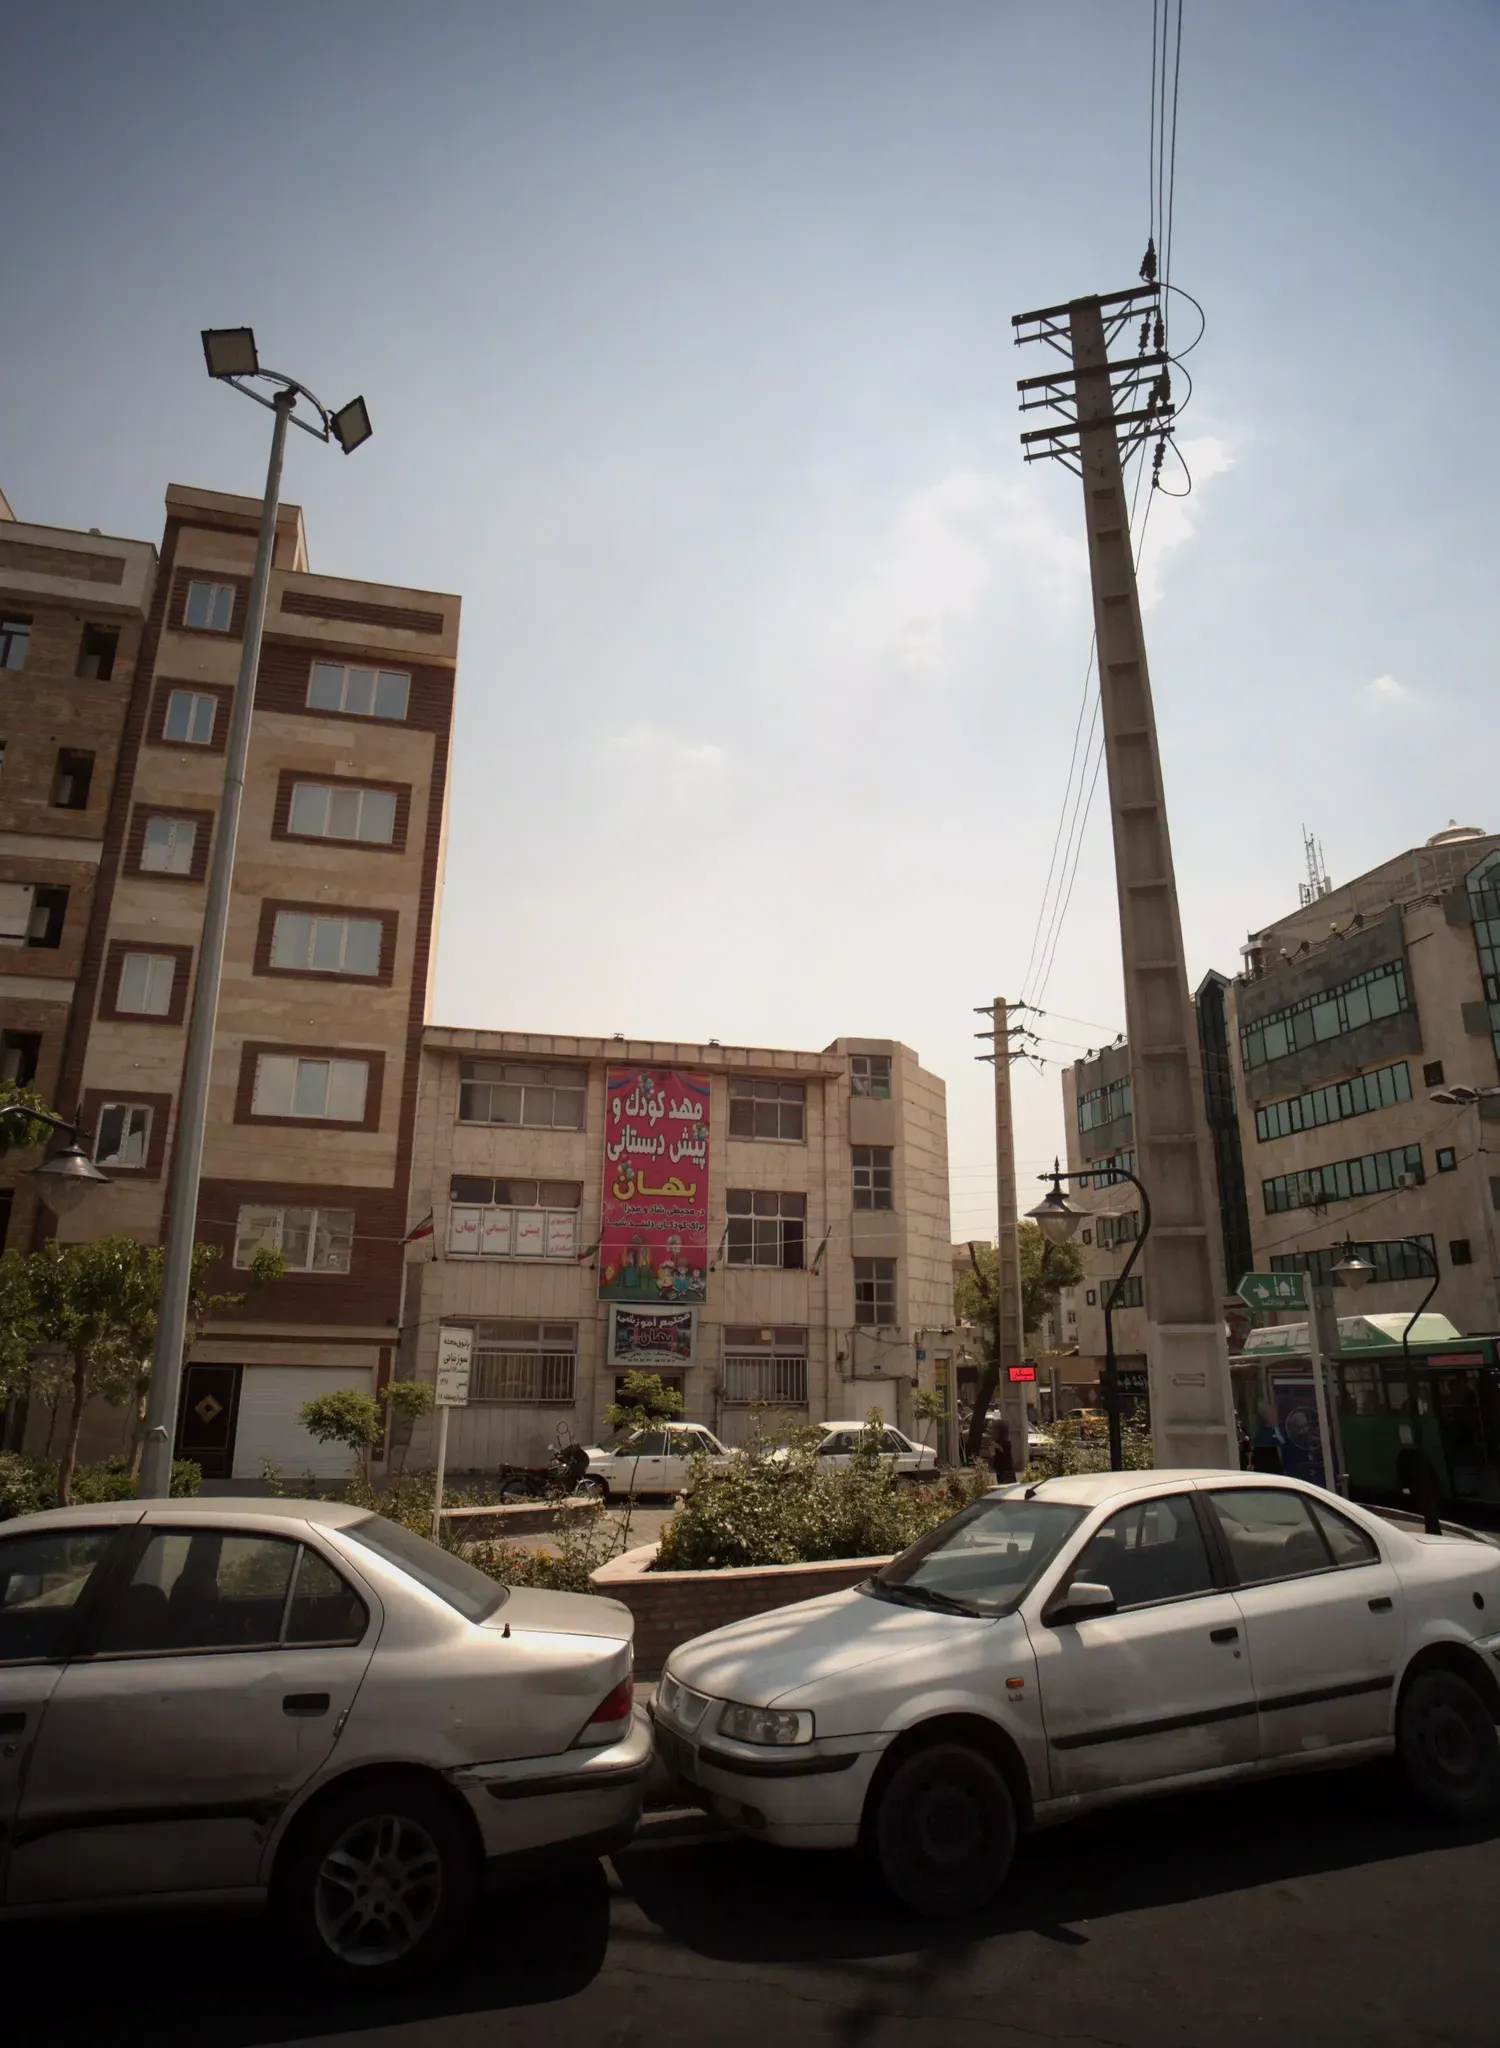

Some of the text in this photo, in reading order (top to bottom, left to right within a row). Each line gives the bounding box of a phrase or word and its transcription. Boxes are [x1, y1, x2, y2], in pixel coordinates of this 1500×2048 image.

[612, 1096, 622, 1125] و
[668, 1096, 703, 1121] مهد
[606, 1123, 706, 1171] پیش دبستانی
[612, 1169, 697, 1204] بهان
[624, 1203, 641, 1214] مجزا
[650, 1204, 665, 1214] شاد
[666, 1206, 695, 1217] محیطی
[696, 1208, 705, 1218] در
[605, 1217, 627, 1228] شما
[656, 1220, 687, 1232] کودکان
[519, 1223, 541, 1238] پیش
[658, 1312, 691, 1329] مجتمع
[638, 1328, 674, 1347] بهان
